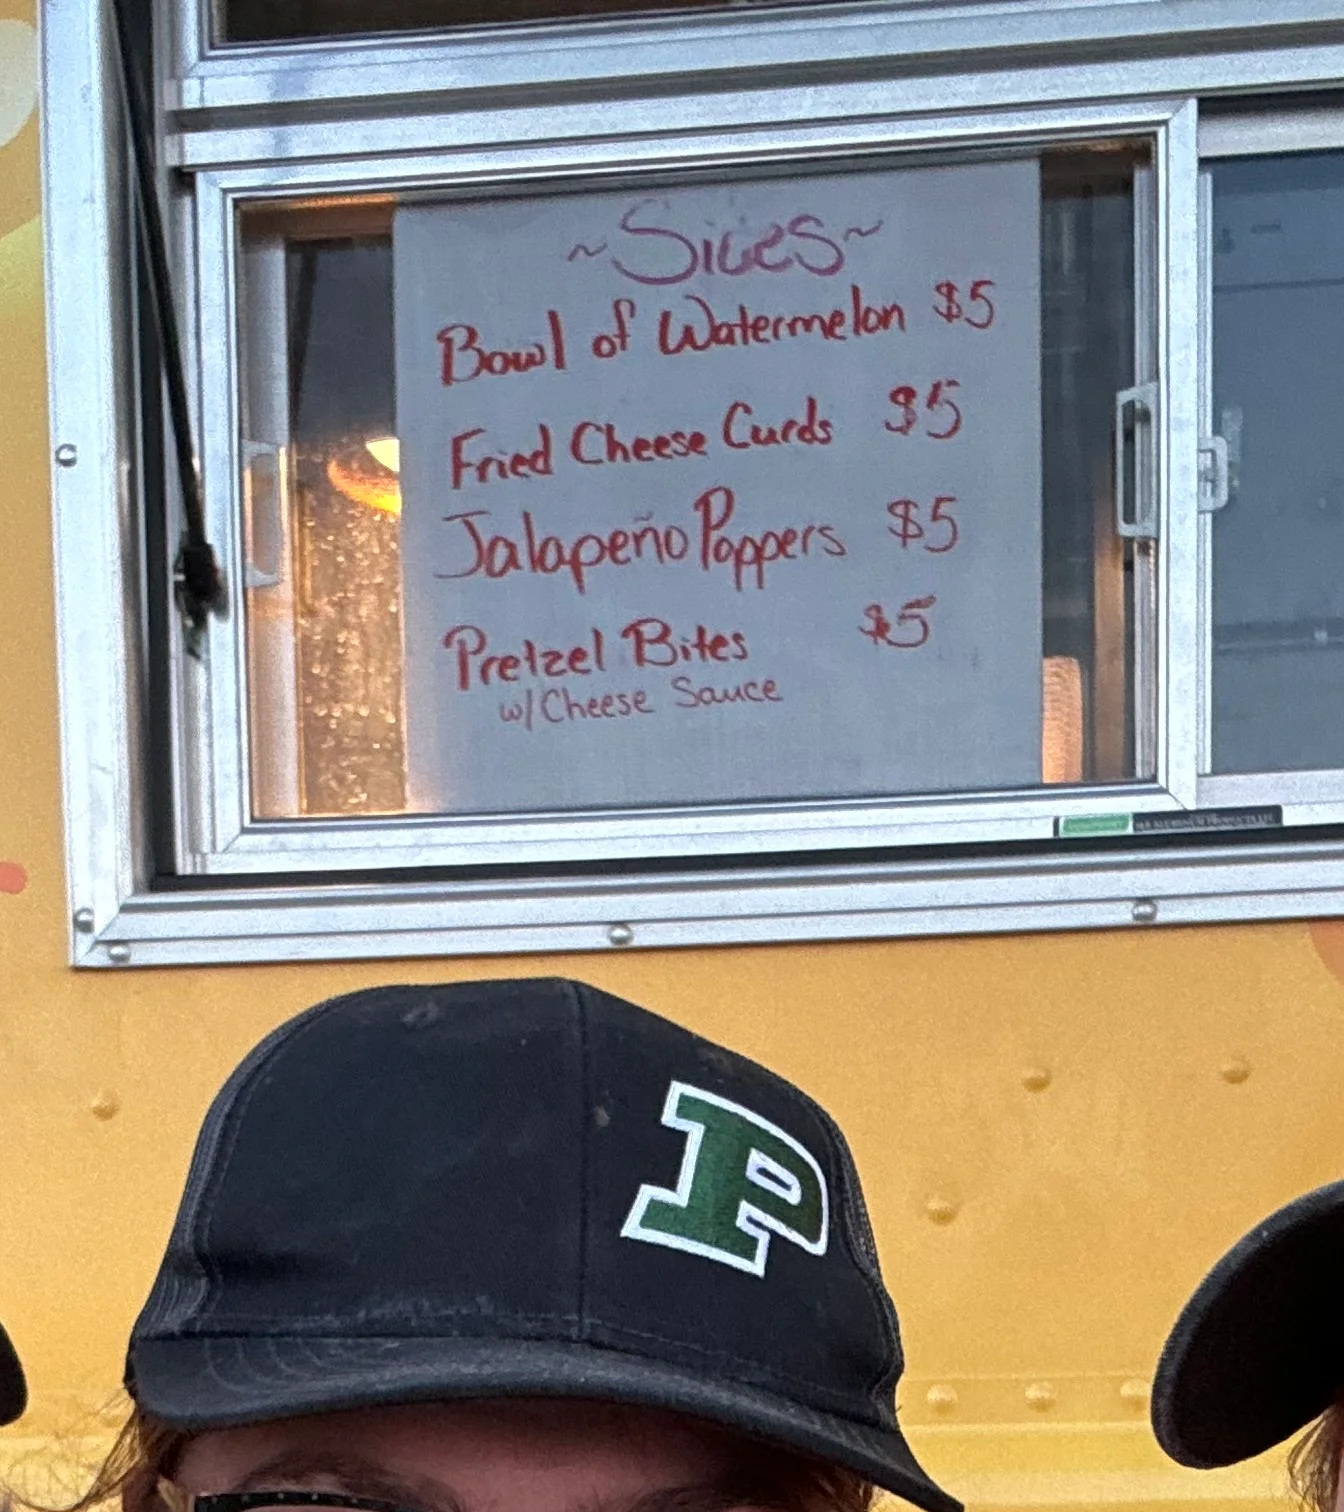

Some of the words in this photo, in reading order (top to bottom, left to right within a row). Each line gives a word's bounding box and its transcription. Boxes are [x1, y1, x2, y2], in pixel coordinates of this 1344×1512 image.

[438, 310, 565, 386] Bowl
[592, 298, 635, 360] of
[659, 286, 906, 356] Watermelon
[933, 280, 998, 330] $5
[451, 429, 552, 491] Fried
[570, 421, 707, 466] Cheese
[722, 396, 834, 449] Curds
[884, 380, 963, 439] $5
[434, 509, 689, 596] Jalapeño
[694, 486, 846, 590] Poppers
[886, 496, 960, 553] $5
[442, 623, 605, 691] Pretzel
[620, 616, 749, 669] Bites
[860, 594, 938, 650] $5
[672, 675, 784, 709] Sauce
[620, 1080, 829, 1279] P
